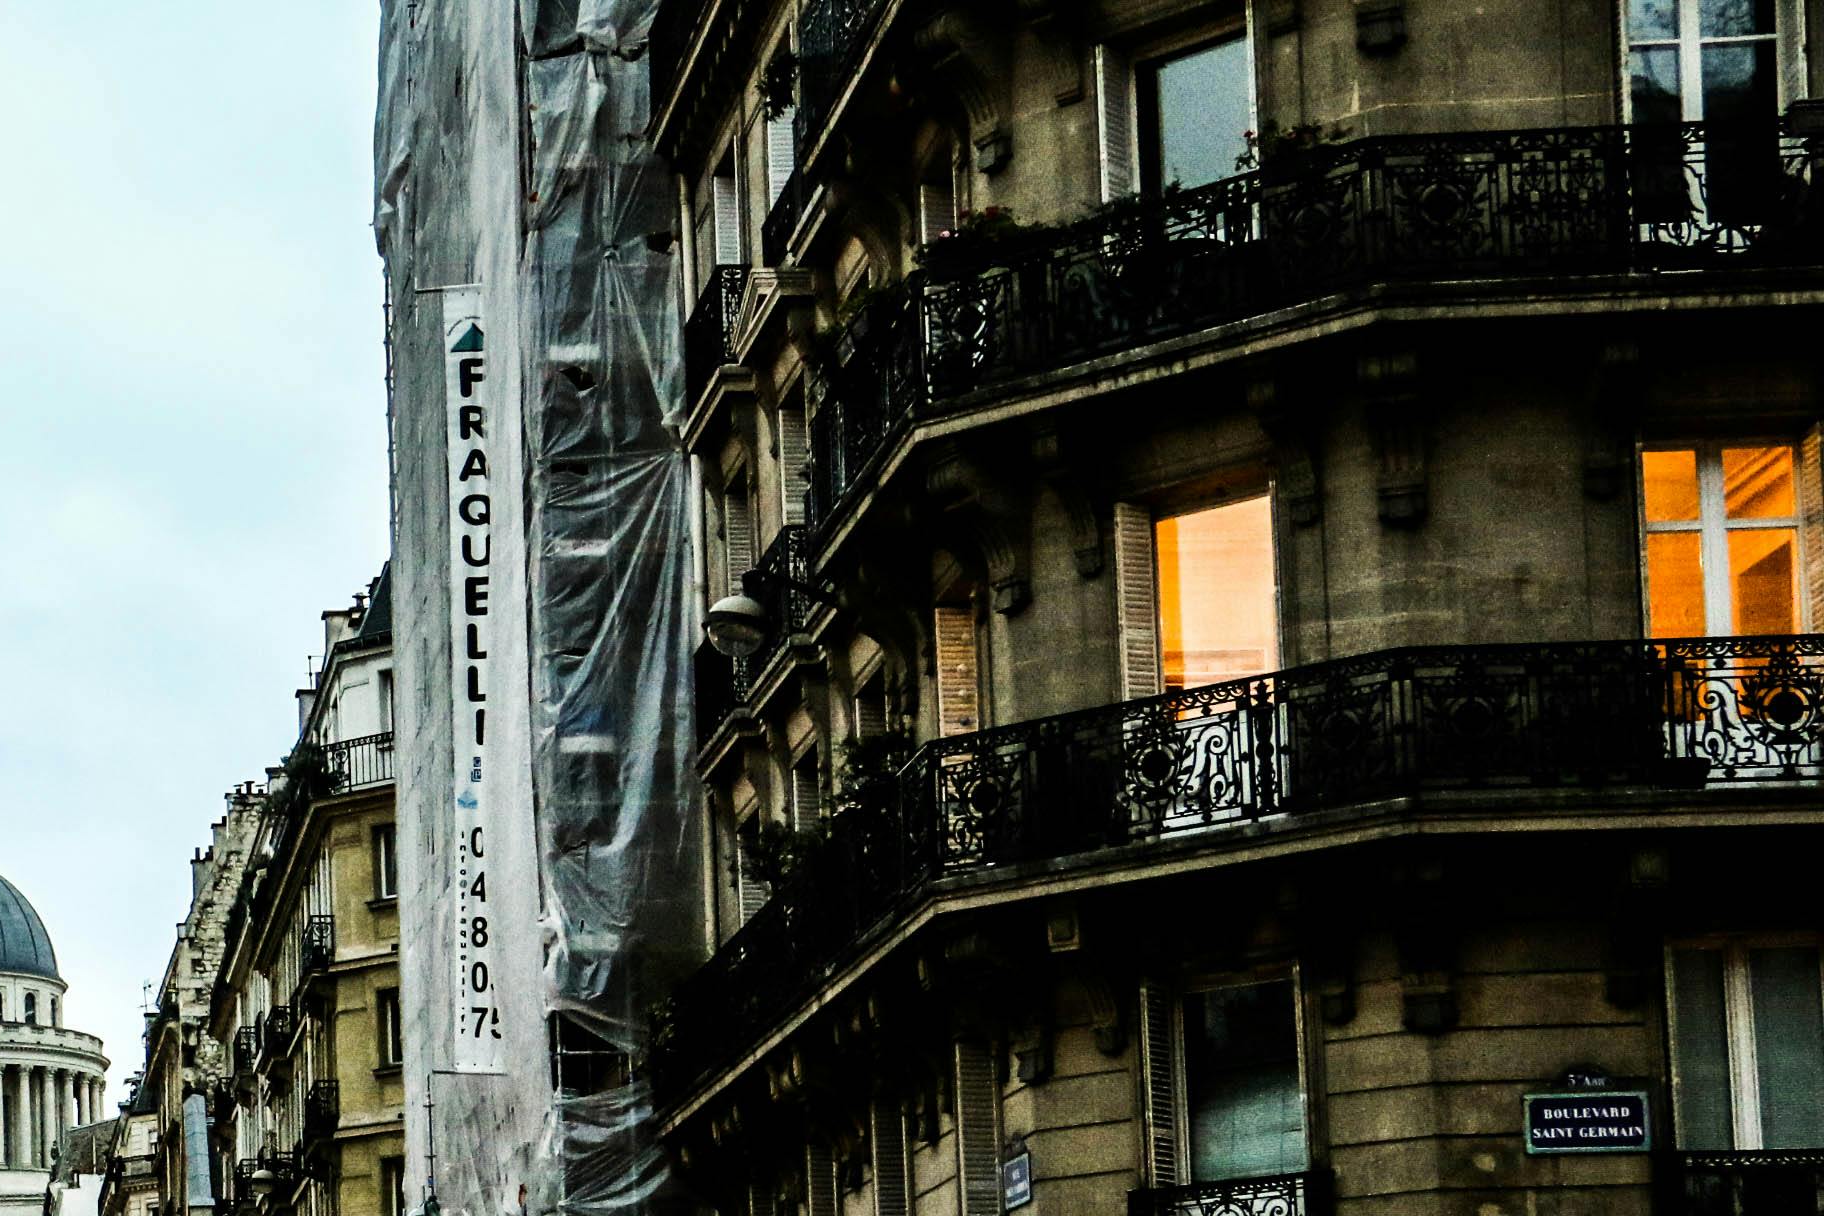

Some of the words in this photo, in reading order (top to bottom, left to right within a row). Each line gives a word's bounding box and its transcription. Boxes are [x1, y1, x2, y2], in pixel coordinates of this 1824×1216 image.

[459, 358, 490, 746] FRAQUELLI
[1543, 1107, 1630, 1120] BOULEVARD
[1533, 1127, 1574, 1139] SAINT
[1579, 1126, 1644, 1138] GERMAIN
